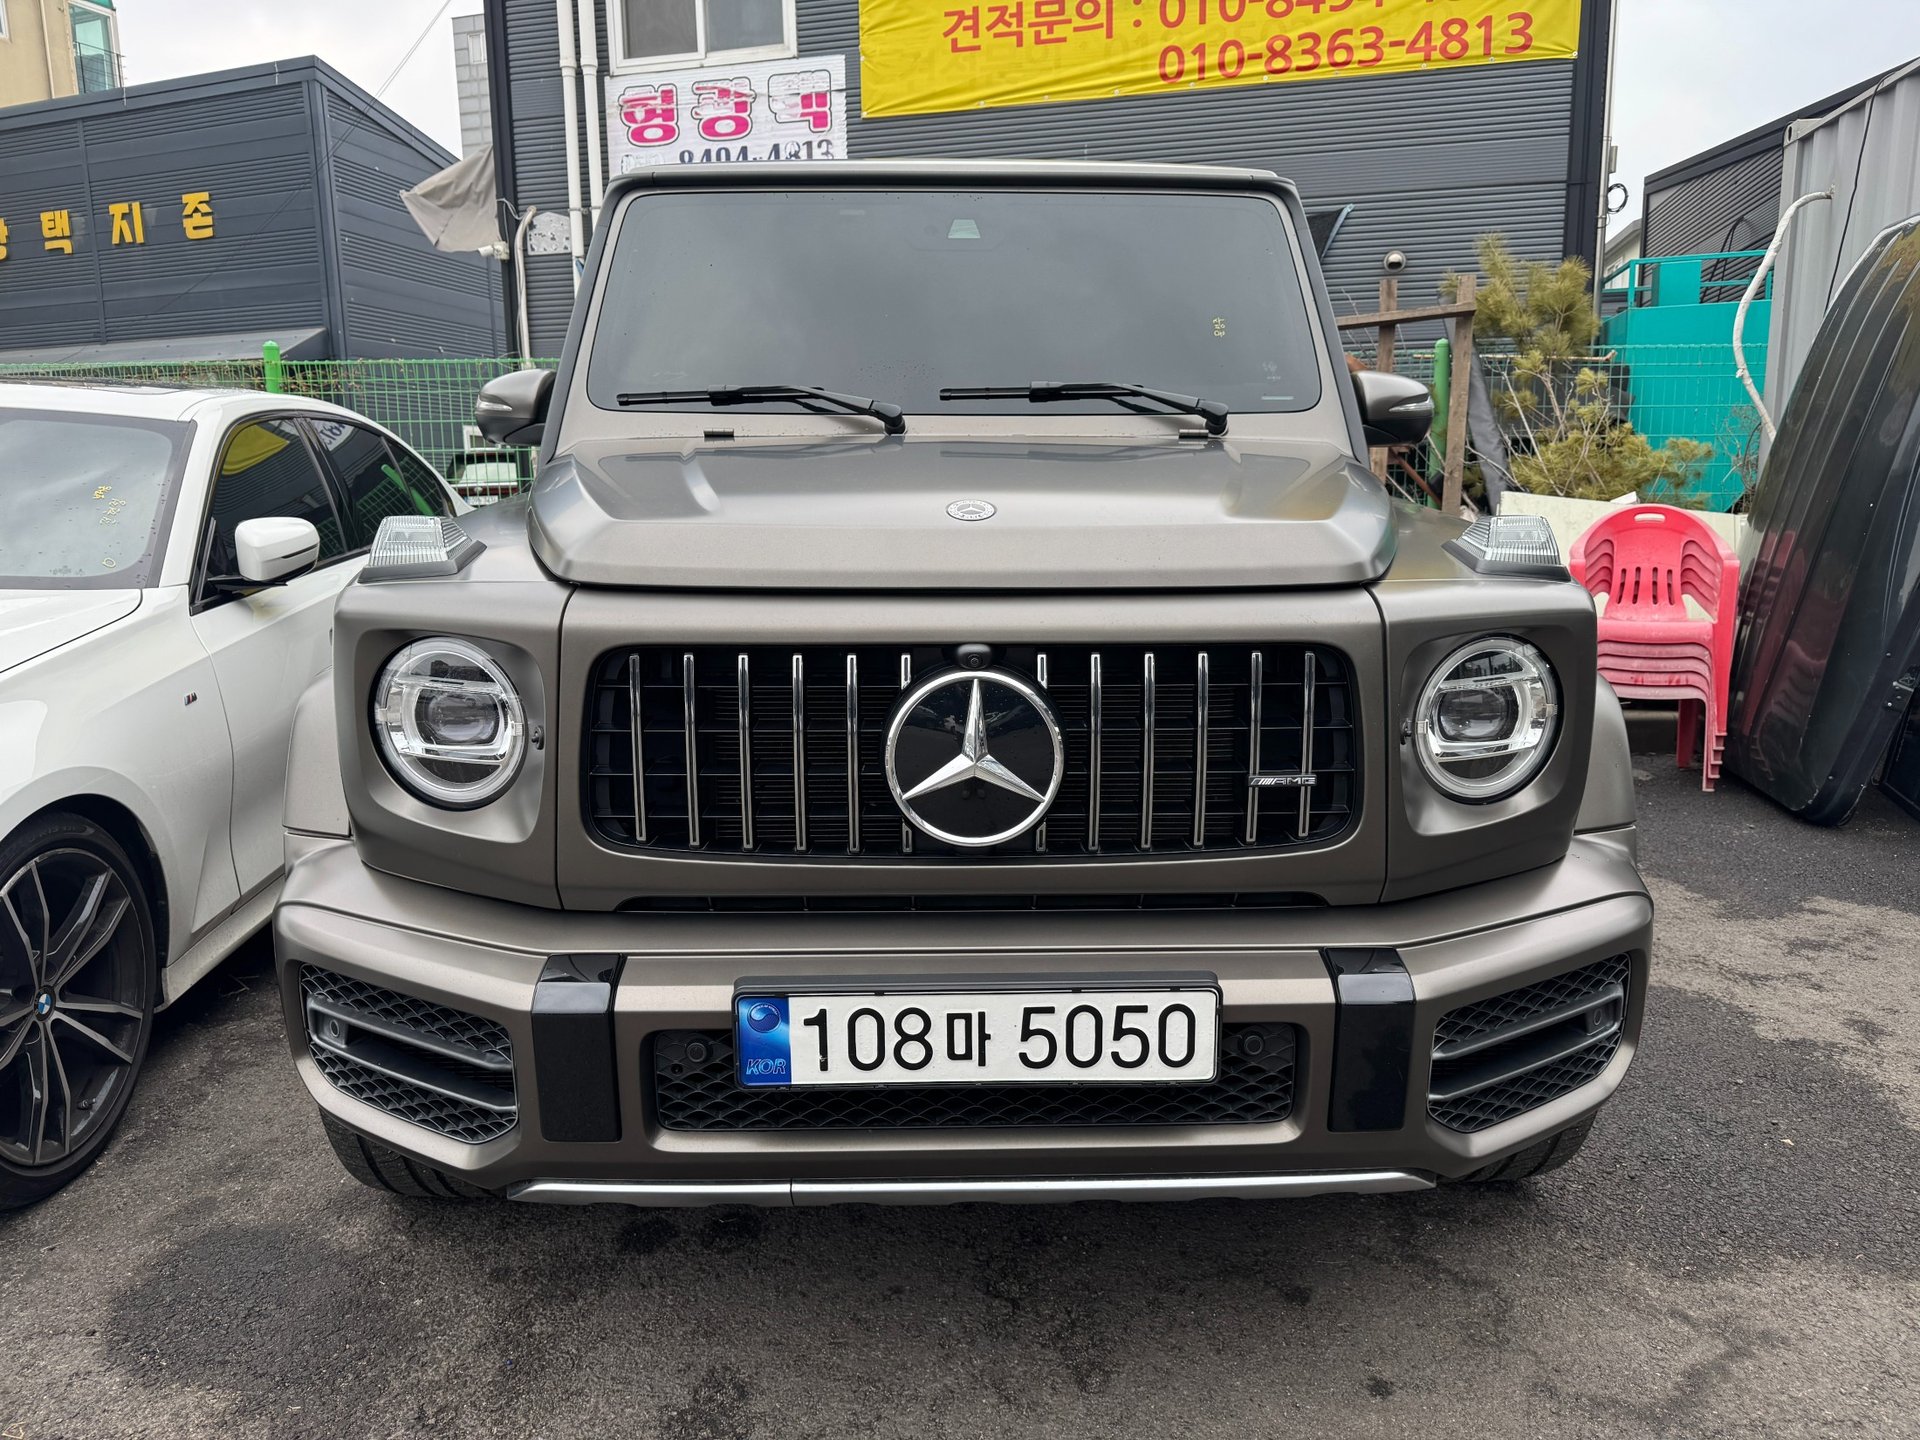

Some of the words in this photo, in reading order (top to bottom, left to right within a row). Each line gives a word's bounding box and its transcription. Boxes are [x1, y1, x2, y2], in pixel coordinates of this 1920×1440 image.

[943, 0, 1114, 54] 견적문의
[1158, 11, 1534, 84] 010-8363-4813
[1271, 776, 1316, 786] AMG
[802, 1007, 992, 1072] 108마
[1018, 1003, 1196, 1069] 5050
[745, 1058, 786, 1075] KOR
